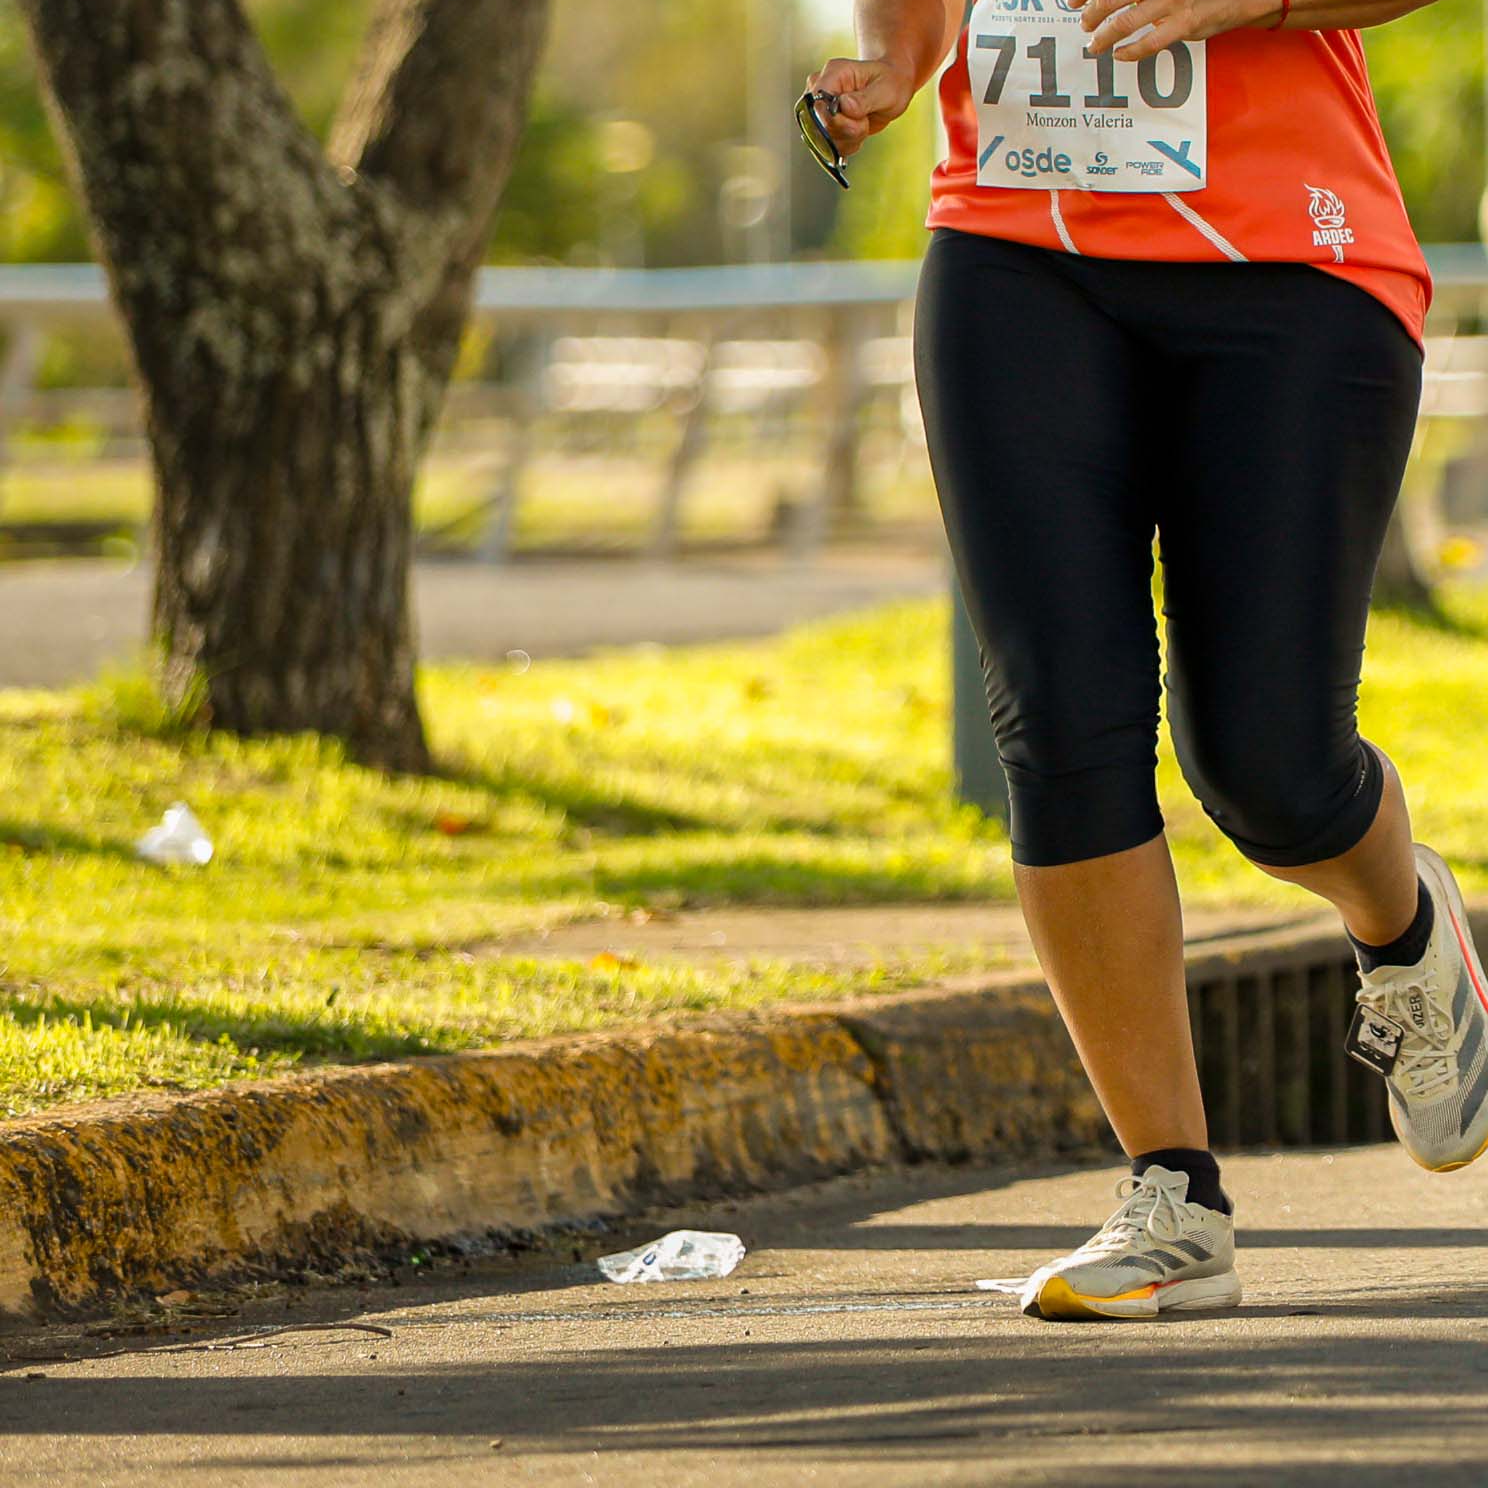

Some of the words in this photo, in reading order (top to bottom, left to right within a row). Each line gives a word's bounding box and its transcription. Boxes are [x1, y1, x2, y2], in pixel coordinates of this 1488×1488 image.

[975, 34, 1193, 109] 7110
[1026, 112, 1077, 128] Monzon
[1082, 113, 1134, 129] Valeria
[1005, 146, 1072, 175] osde
[1311, 227, 1355, 247] ARDEC
